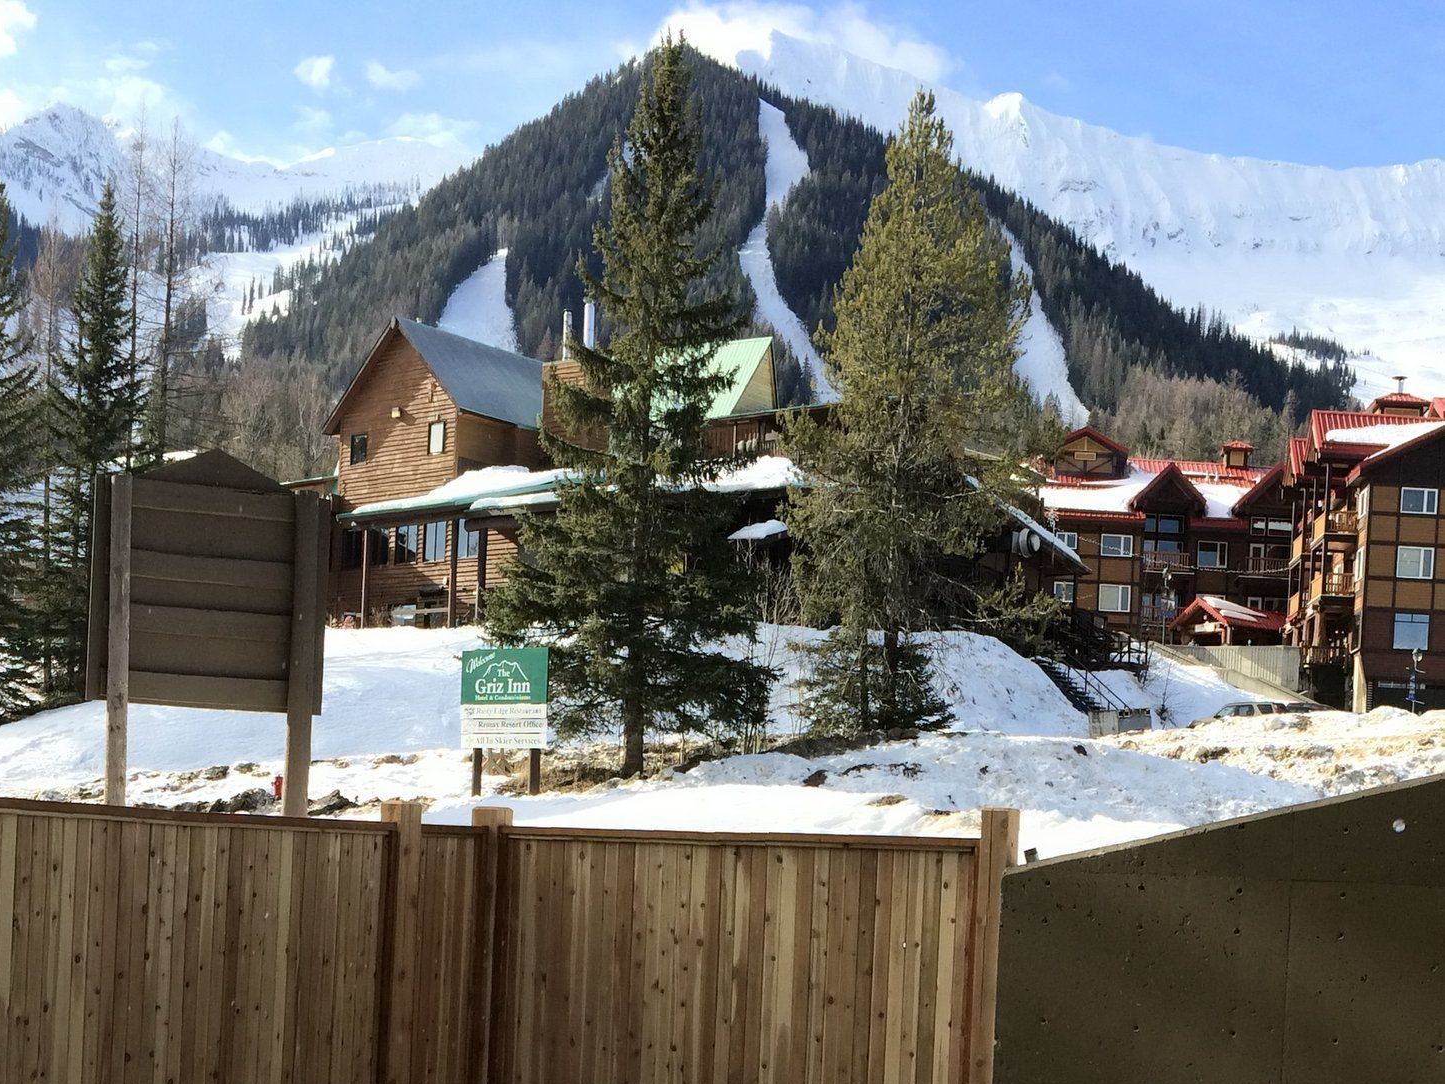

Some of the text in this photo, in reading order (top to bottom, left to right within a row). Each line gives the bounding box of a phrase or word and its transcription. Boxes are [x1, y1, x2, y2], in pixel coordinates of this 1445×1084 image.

[497, 669, 510, 677] The
[475, 678, 531, 694] Griz Inn
